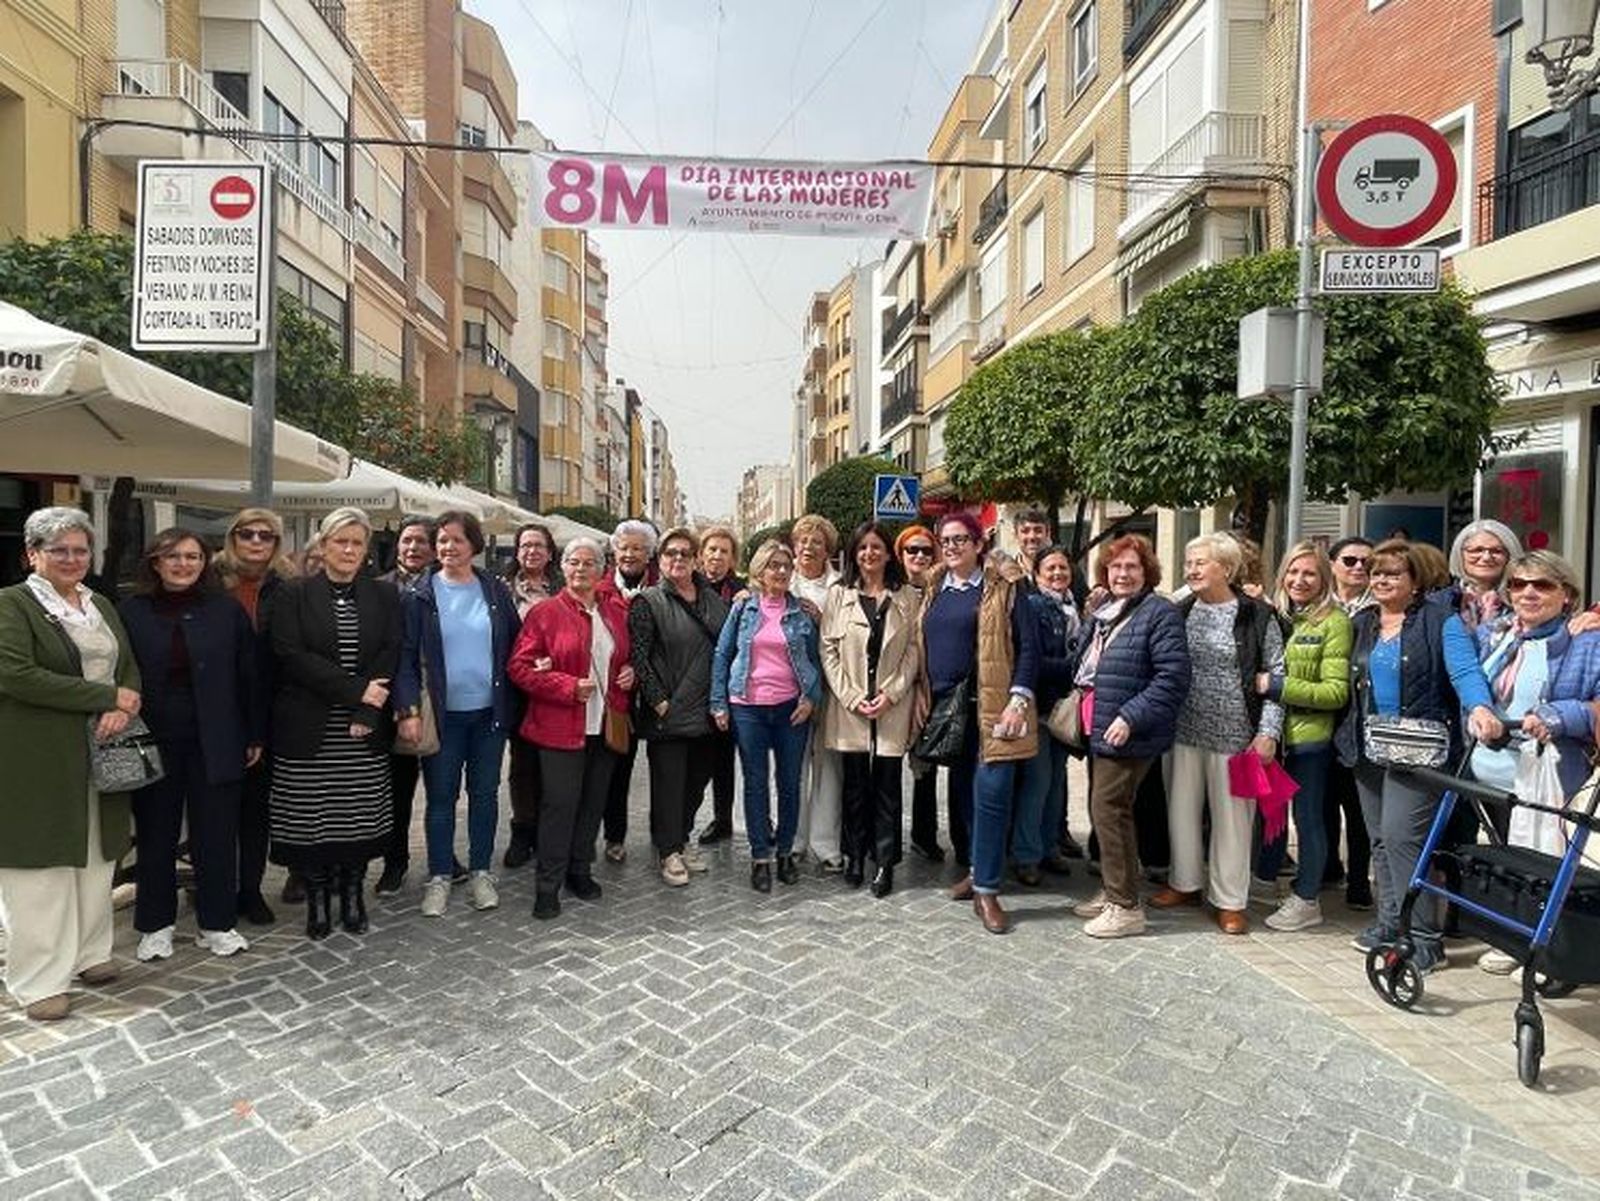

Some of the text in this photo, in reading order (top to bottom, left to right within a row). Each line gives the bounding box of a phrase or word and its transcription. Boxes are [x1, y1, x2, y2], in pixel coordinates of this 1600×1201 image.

[727, 167, 916, 189] INTERNACIONAL
[545, 158, 669, 225] 8M
[708, 185, 890, 209] DE LAS MUJERES
[1365, 190, 1406, 204] 3,5 T
[146, 255, 255, 274] FESTIVOS Y NOCHES DE
[1341, 255, 1421, 270] EXCEPTO
[1327, 272, 1434, 286] SERVICIOS MUNICIPALES
[145, 283, 188, 301] VERANO
[222, 283, 253, 302] REINA
[144, 311, 253, 329] CORTADA AL TRAFICO
